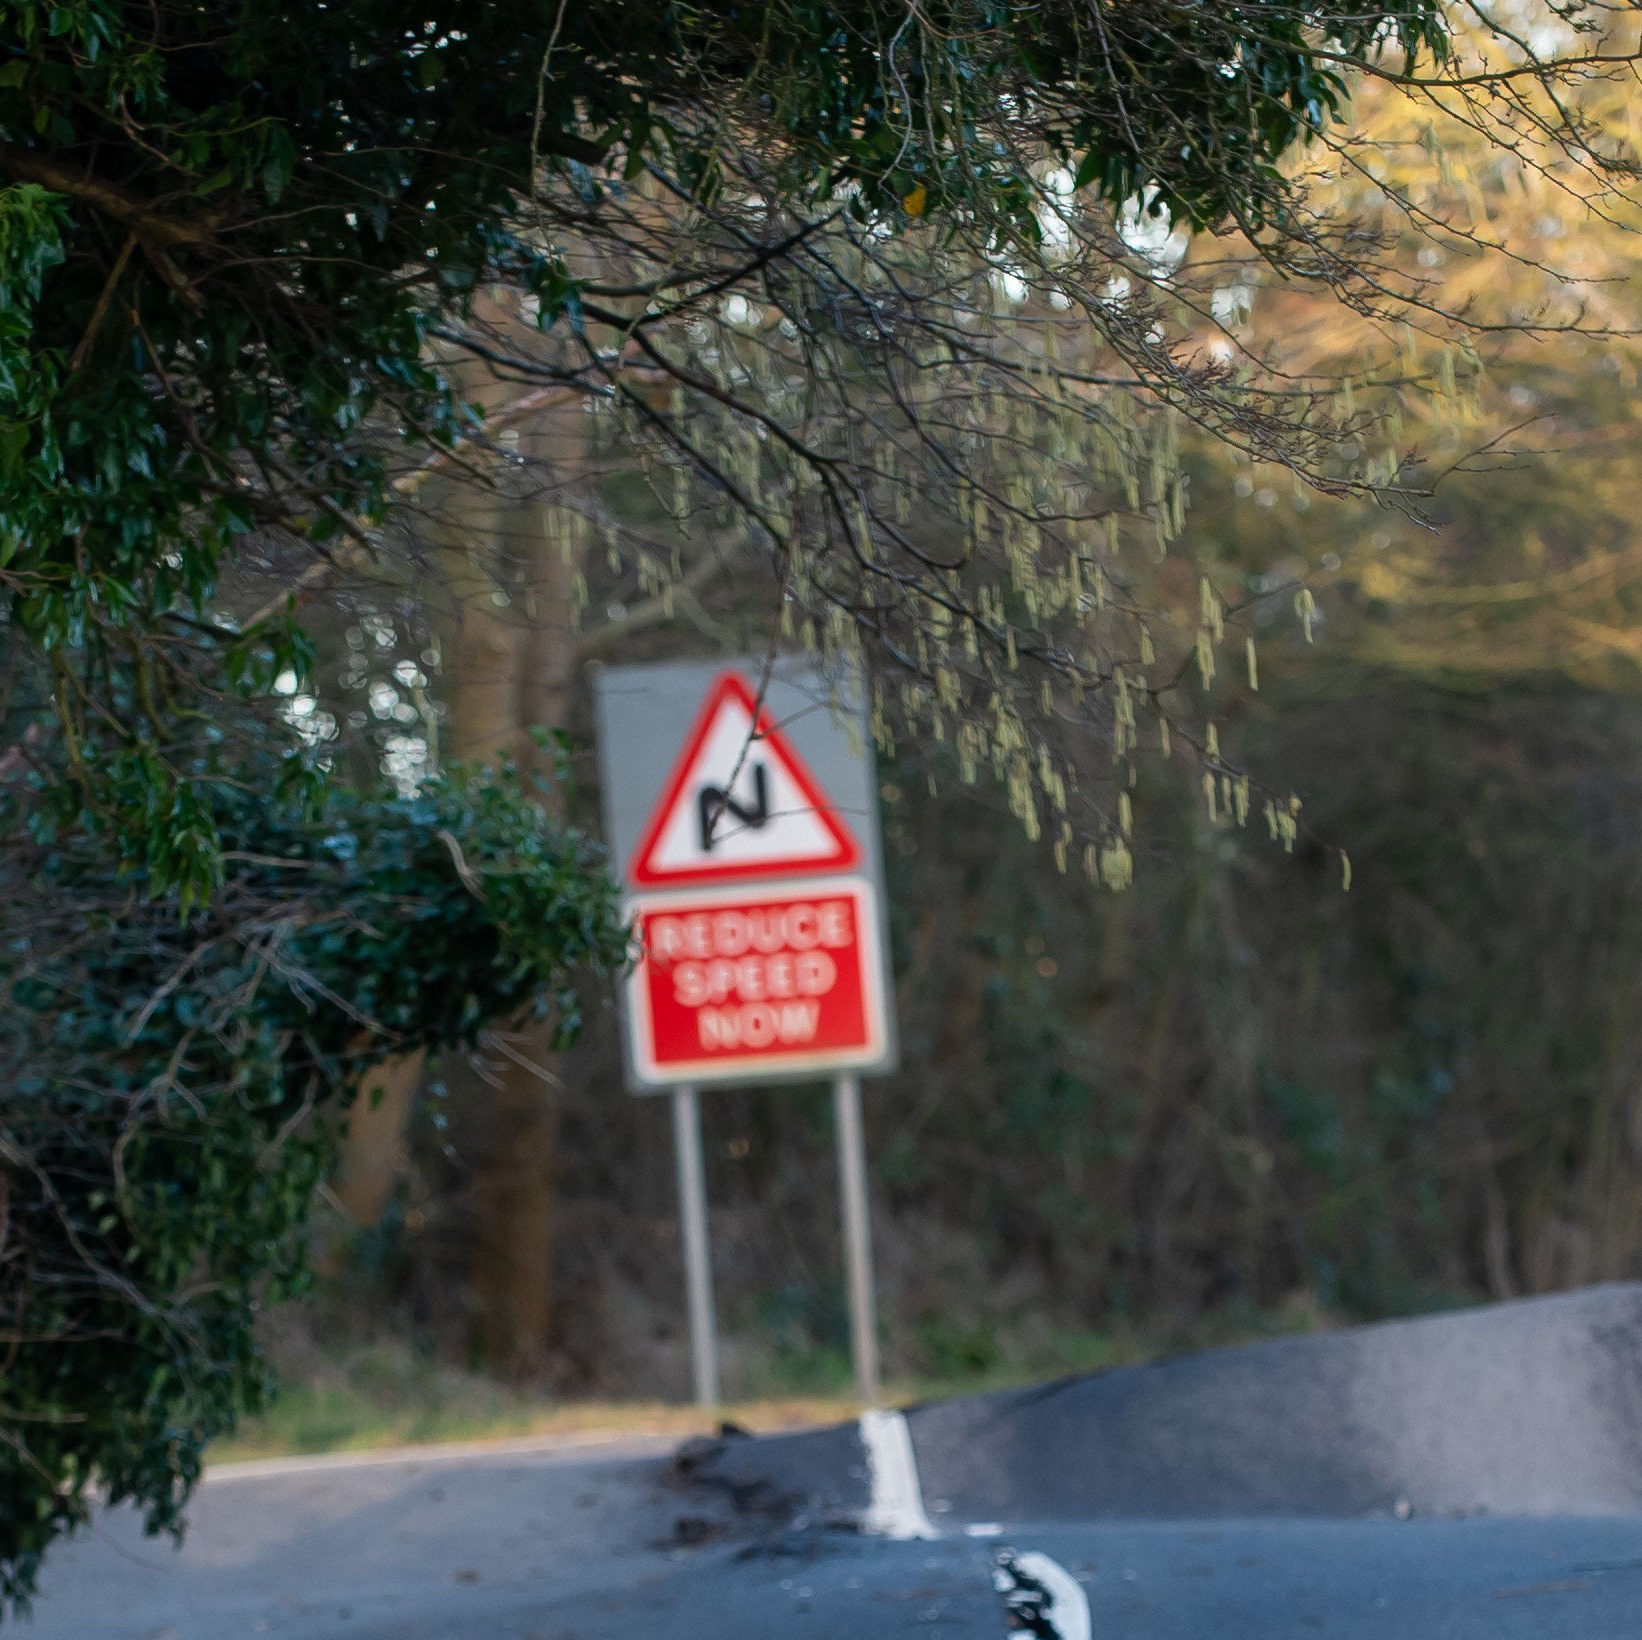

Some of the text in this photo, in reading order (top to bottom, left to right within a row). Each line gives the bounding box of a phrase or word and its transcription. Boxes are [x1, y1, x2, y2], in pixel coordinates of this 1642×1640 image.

[651, 901, 850, 963] REDUCE
[673, 950, 836, 1006] SPEED
[698, 999, 821, 1051] NOW
